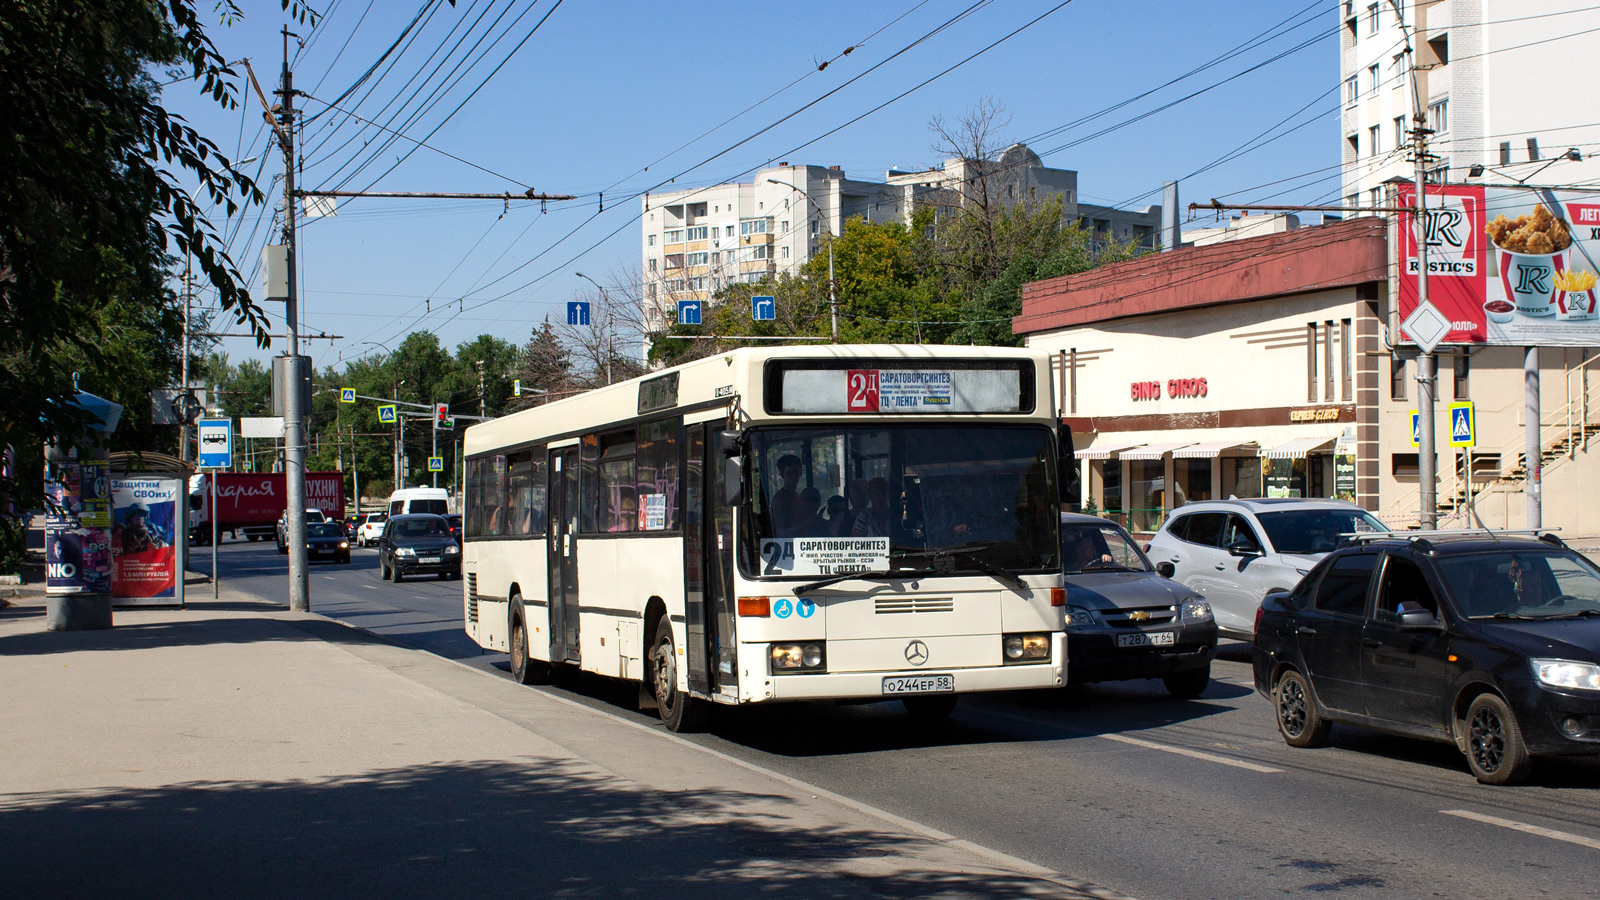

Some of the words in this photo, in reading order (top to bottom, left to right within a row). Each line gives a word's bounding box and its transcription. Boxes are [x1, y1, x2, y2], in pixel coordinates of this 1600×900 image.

[1579, 208, 1600, 221] ЛЕГ
[1409, 262, 1474, 272] RSTIC'S
[1452, 321, 1478, 331] ОЛЛ»
[880, 372, 951, 384] САРАТОВОРГСИНТЕЗ
[1130, 381, 1161, 401] BING
[1166, 377, 1208, 399] GIROS
[880, 396, 890, 408] ТЦ
[892, 396, 922, 407] "ЛЕНТА"
[112, 480, 160, 489] Защитим
[799, 540, 886, 551] САРАТОВОРГСИНТЕЗ
[818, 565, 832, 574] ТЦ
[1161, 632, 1171, 641] 64
[888, 679, 934, 692] О244ЕР
[937, 677, 949, 686] 58
